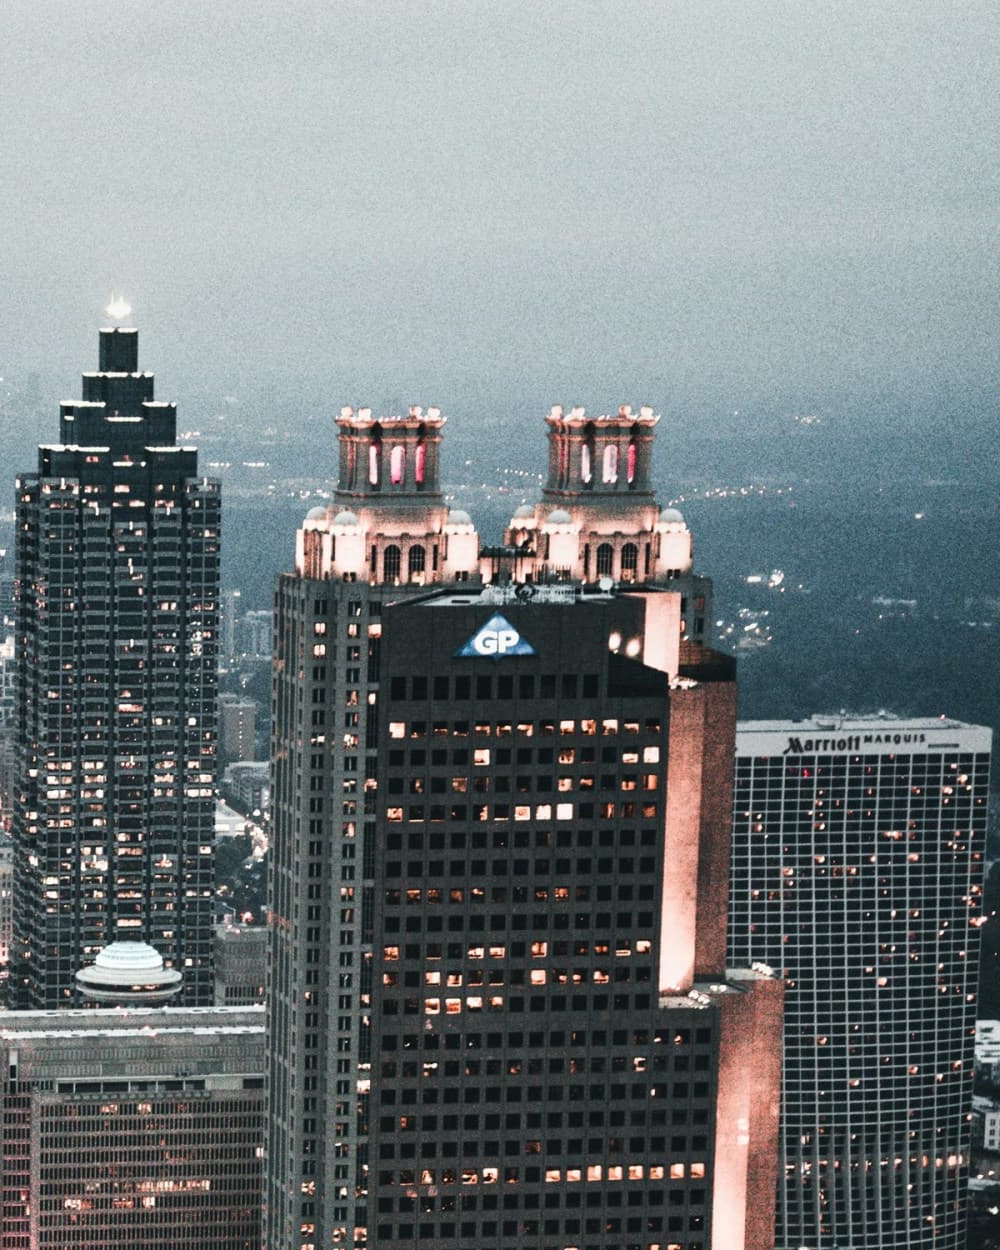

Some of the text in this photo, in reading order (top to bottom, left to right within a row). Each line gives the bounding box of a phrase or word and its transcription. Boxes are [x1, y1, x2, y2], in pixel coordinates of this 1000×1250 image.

[474, 630, 520, 655] GP
[782, 733, 925, 754] Marriott MARQUIS
